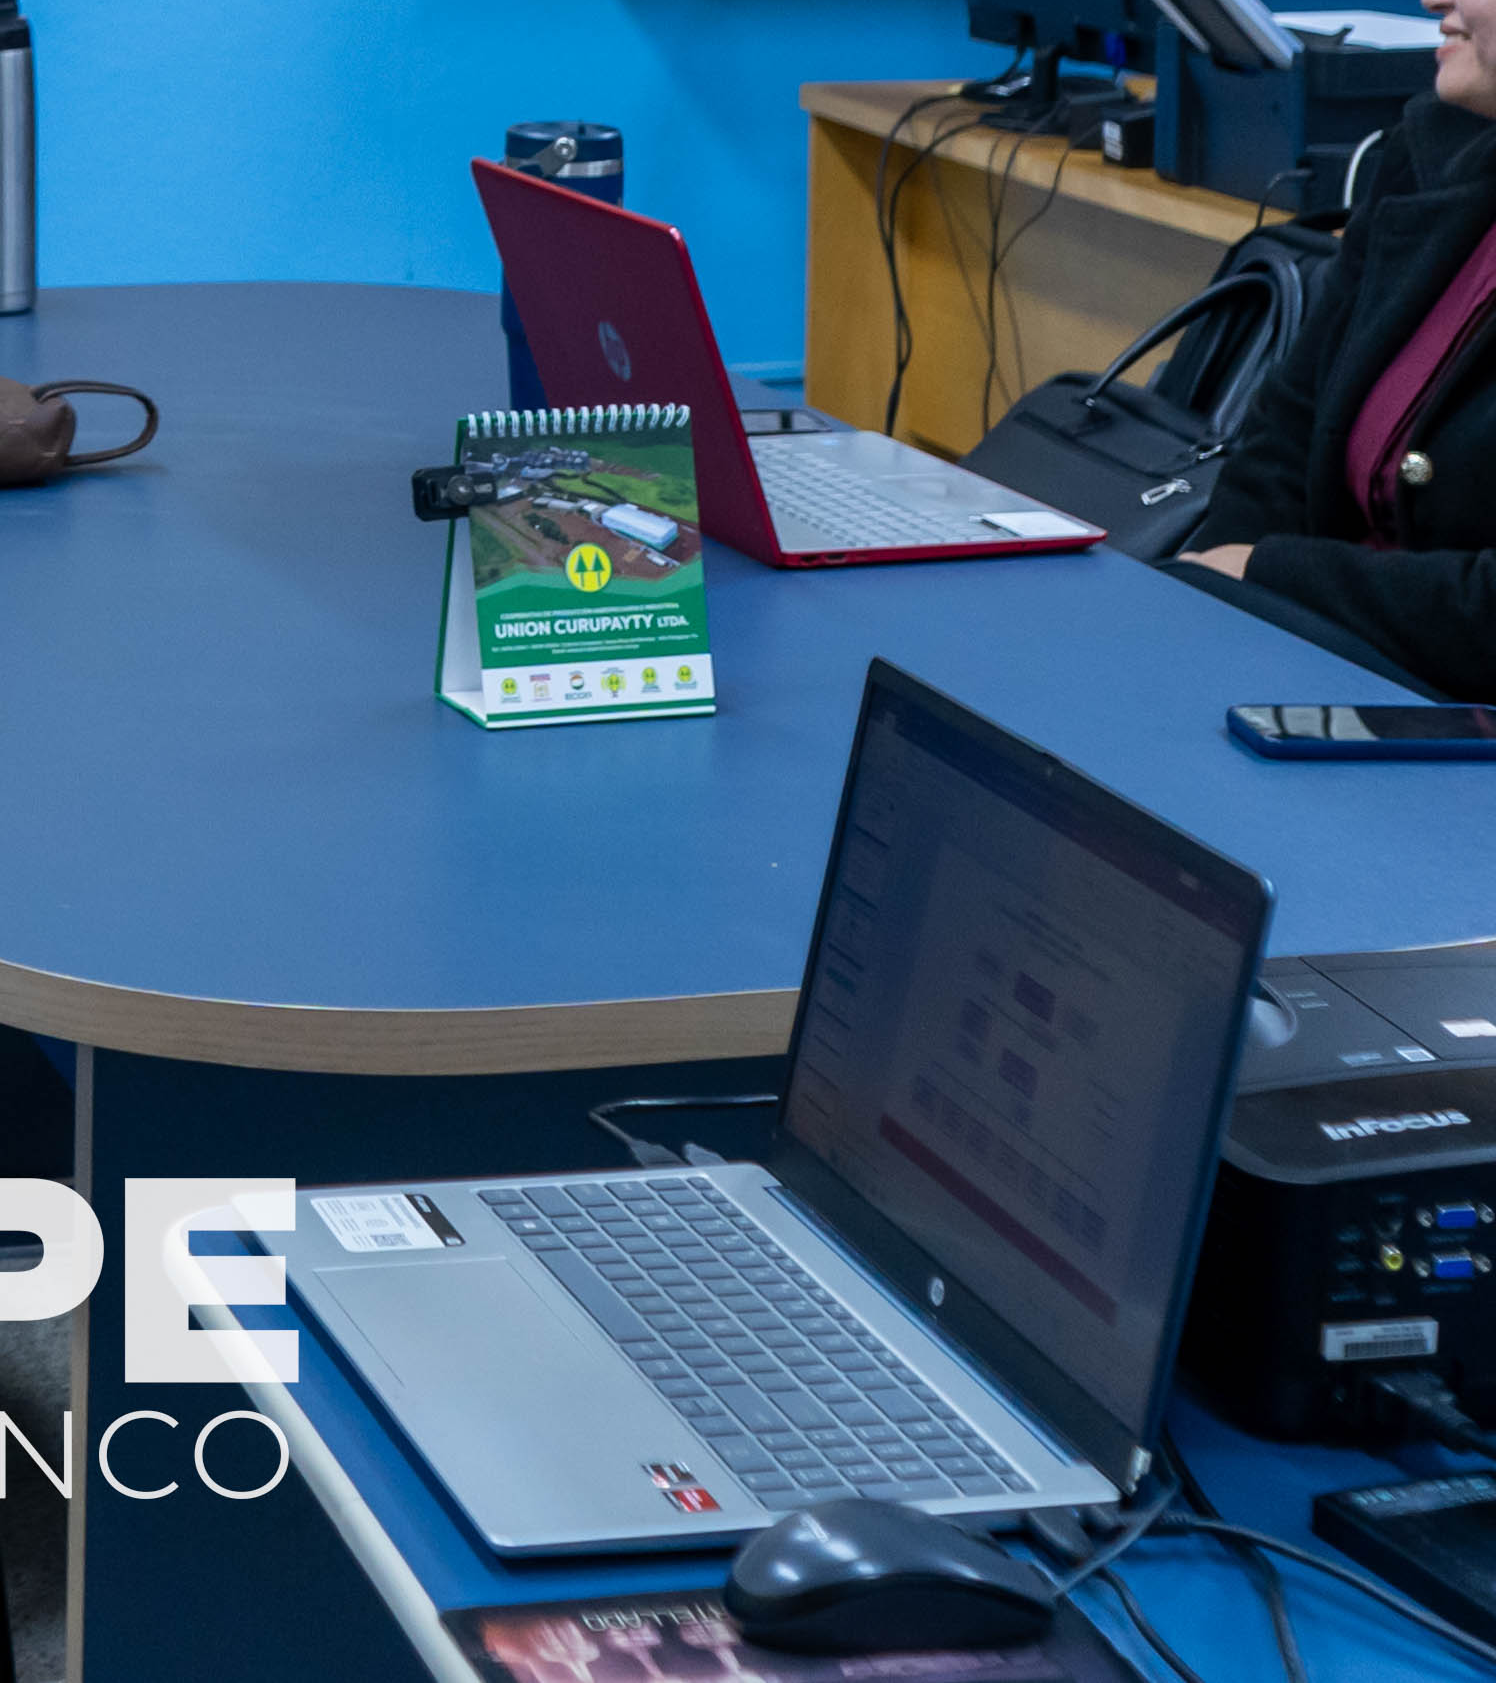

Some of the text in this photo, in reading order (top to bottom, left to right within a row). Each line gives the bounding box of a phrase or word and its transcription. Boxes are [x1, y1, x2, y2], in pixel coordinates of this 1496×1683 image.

[495, 620, 551, 638] UNION
[554, 614, 654, 635] CURUPAYTY
[1320, 1108, 1472, 1142] InFocus
